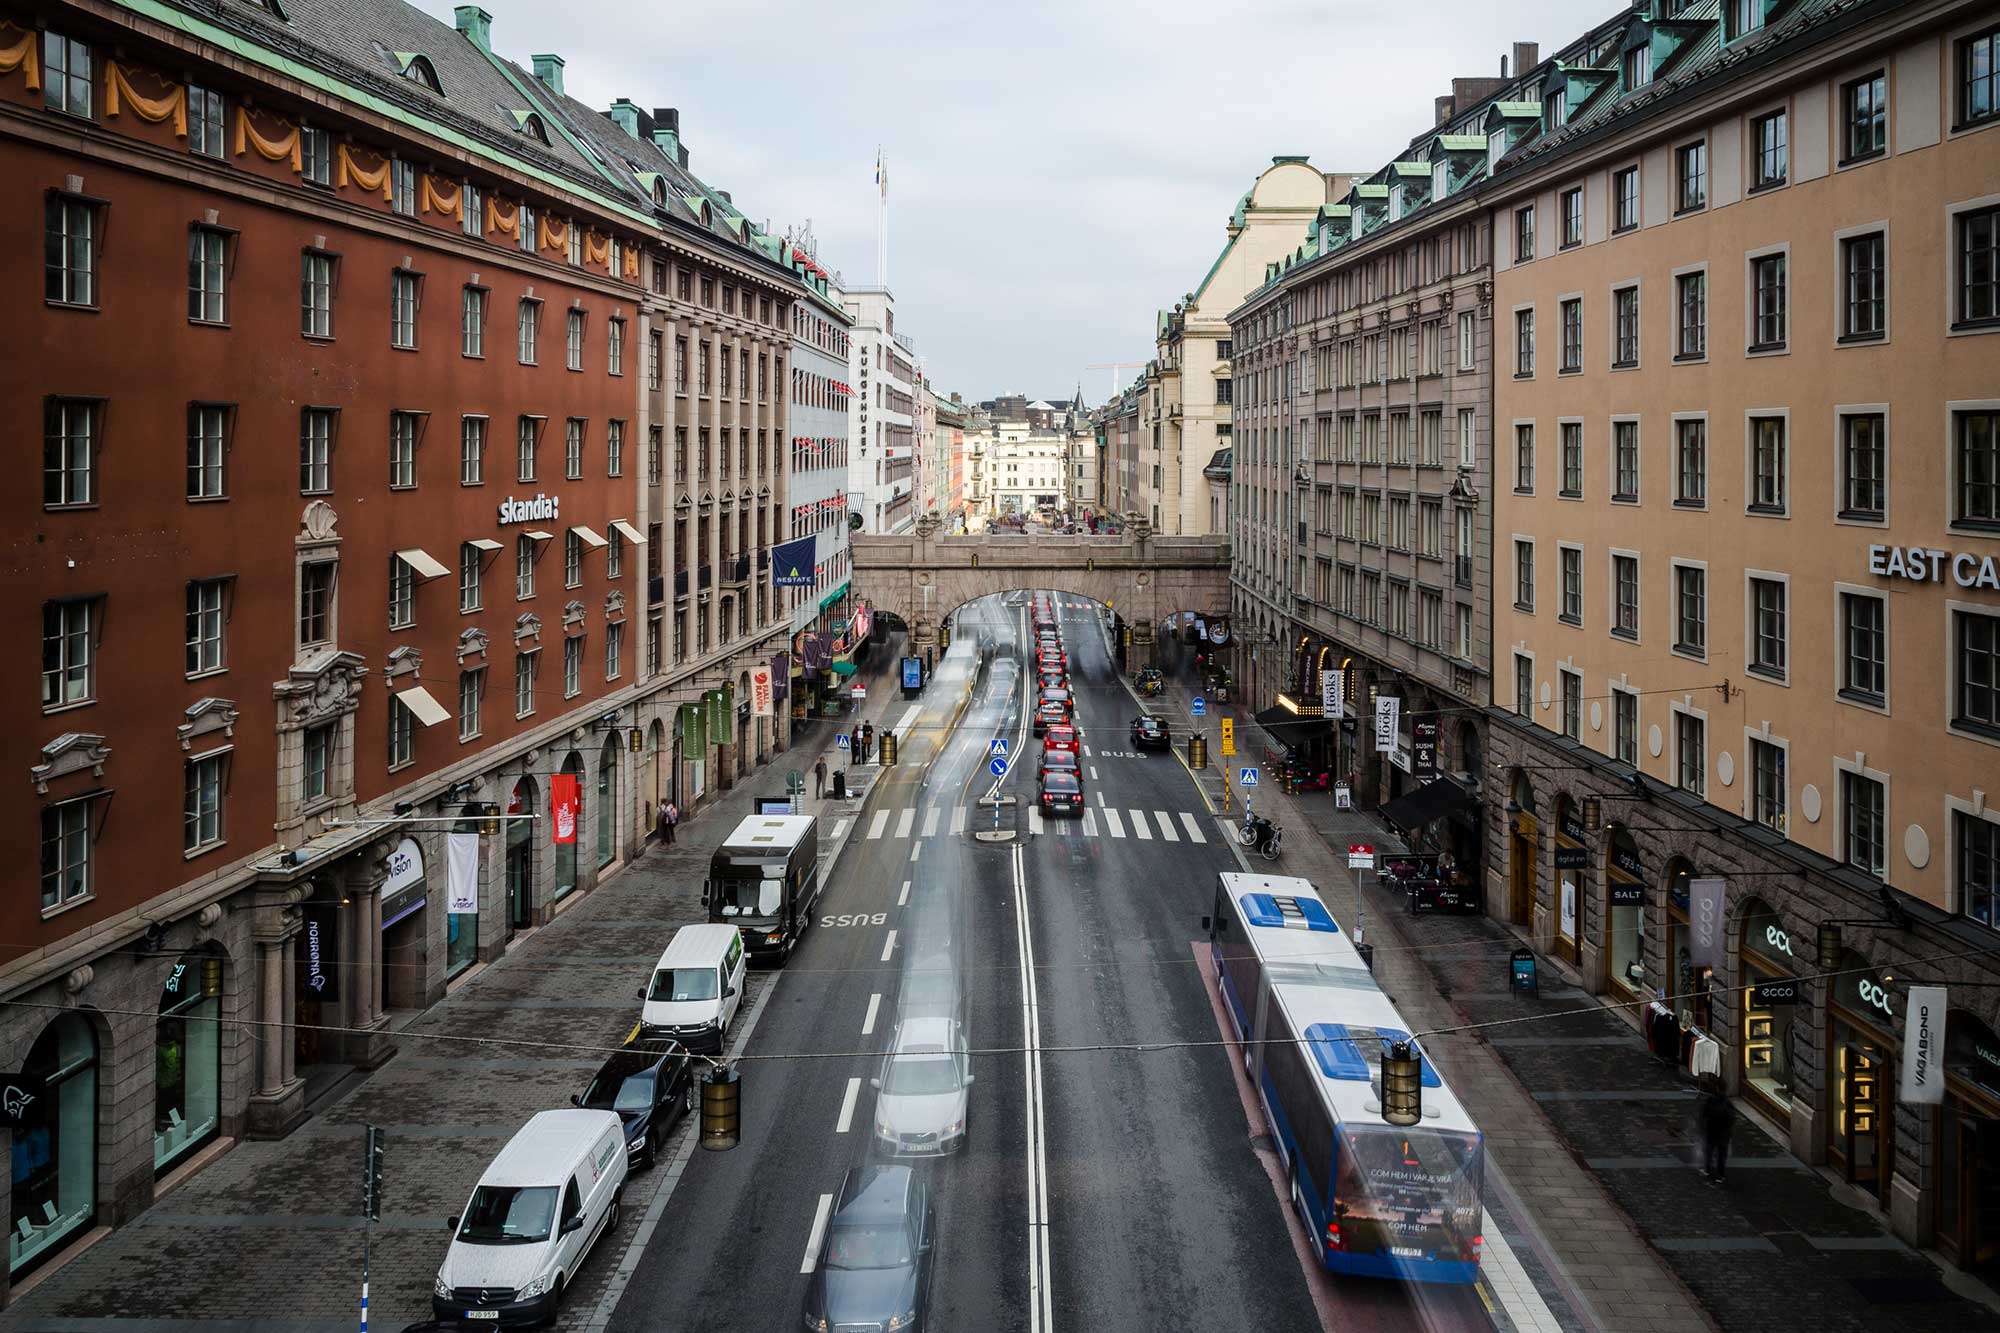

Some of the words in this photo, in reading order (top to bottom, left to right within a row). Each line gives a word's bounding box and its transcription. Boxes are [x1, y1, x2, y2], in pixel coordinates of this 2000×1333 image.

[1869, 544, 1945, 582] EAST
[1325, 673, 1336, 714] Hööks
[1378, 701, 1392, 746] Hööks
[1101, 750, 1147, 759] BUSS
[1420, 751, 1429, 760] &
[1614, 890, 1641, 899] SALT
[820, 912, 888, 928] BUSS
[1700, 898, 1713, 948] ecco
[309, 921, 321, 977] NORRØNA
[1766, 925, 1793, 956] ecc
[1859, 979, 1893, 1016] ecc
[1915, 1006, 1928, 1087] VAGABOND
[1403, 1141, 1409, 1156] 1
[1370, 1168, 1390, 1177] COM
[1390, 1170, 1408, 1180] HEM
[1388, 1221, 1407, 1231] COM
[1408, 1223, 1428, 1232] HEM
